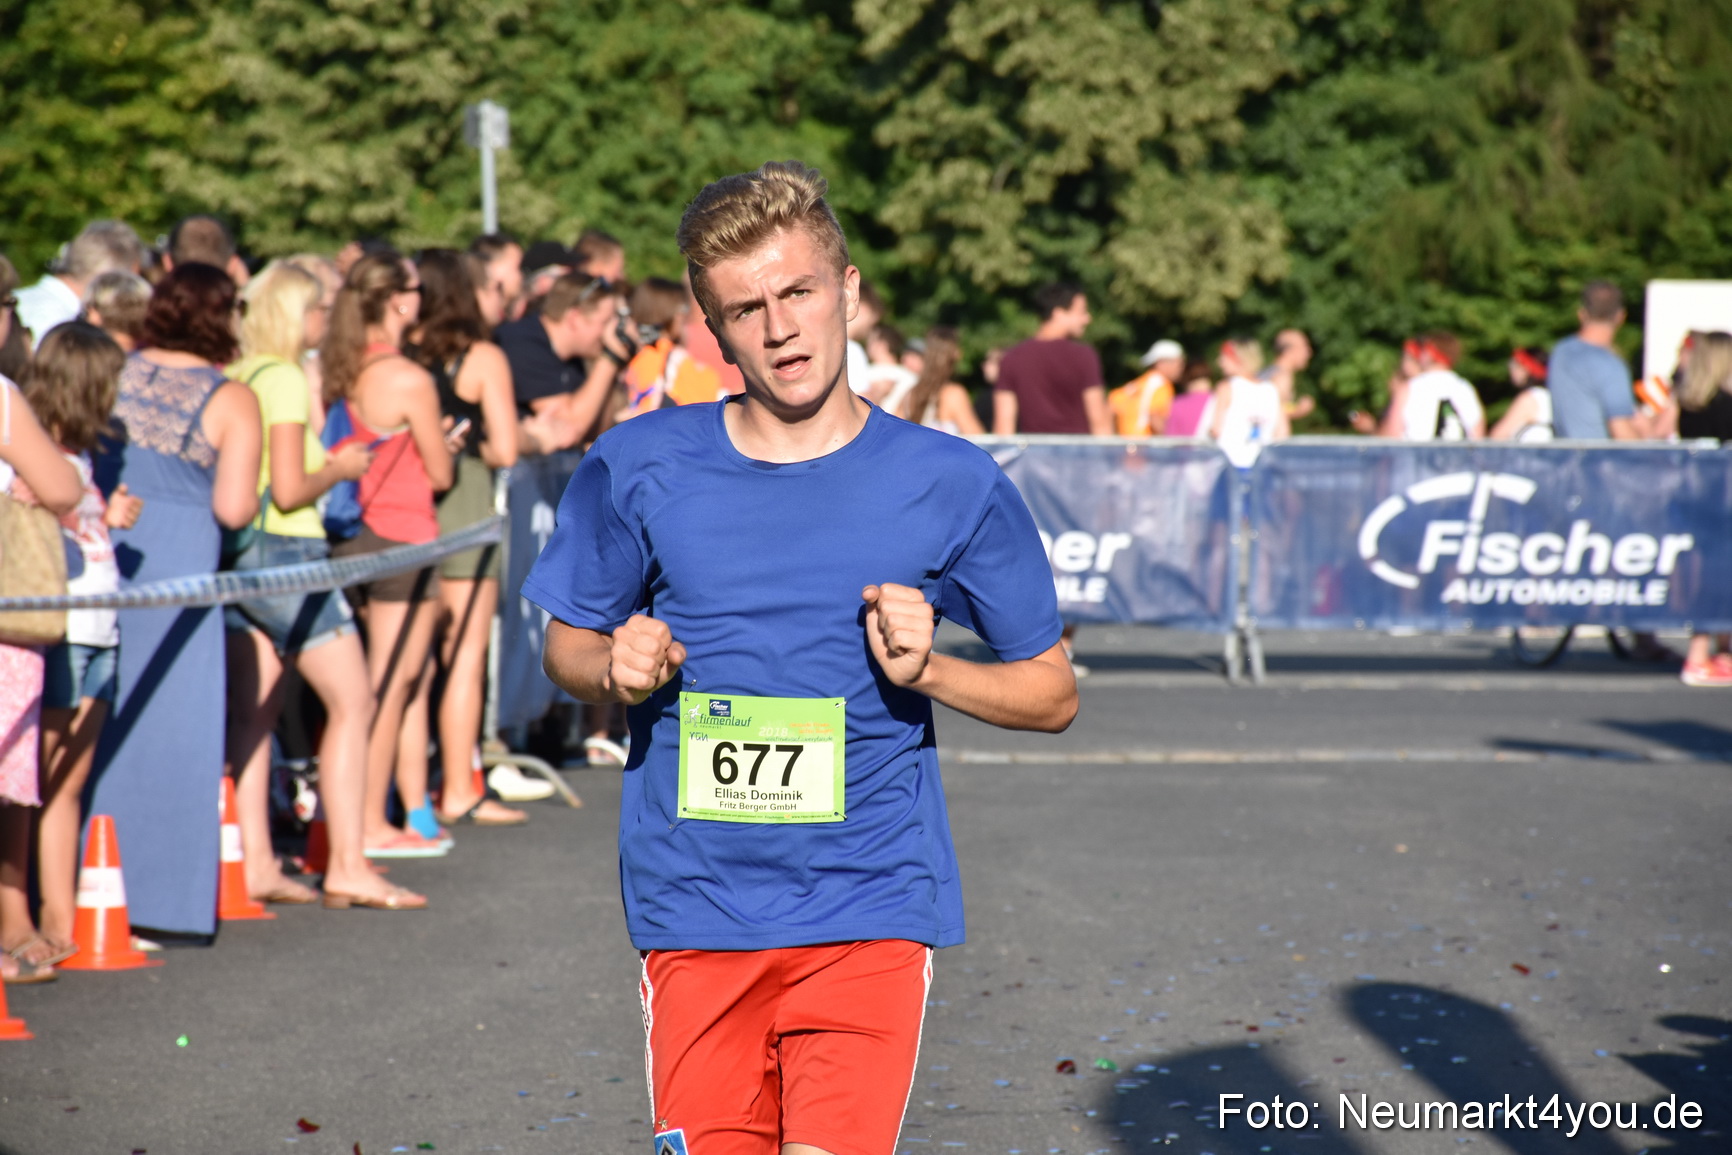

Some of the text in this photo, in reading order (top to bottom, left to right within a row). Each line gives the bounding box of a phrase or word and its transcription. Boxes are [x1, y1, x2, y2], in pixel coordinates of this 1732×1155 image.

[1417, 519, 1694, 575] Fischer
[1440, 578, 1669, 606] AUTOMOBILE
[699, 713, 752, 727] firmenlauf
[758, 726, 788, 737] 2018
[712, 741, 804, 787] 677
[715, 787, 803, 800] Ellias Dominik
[719, 801, 797, 812] Fritz Berger GmbH
